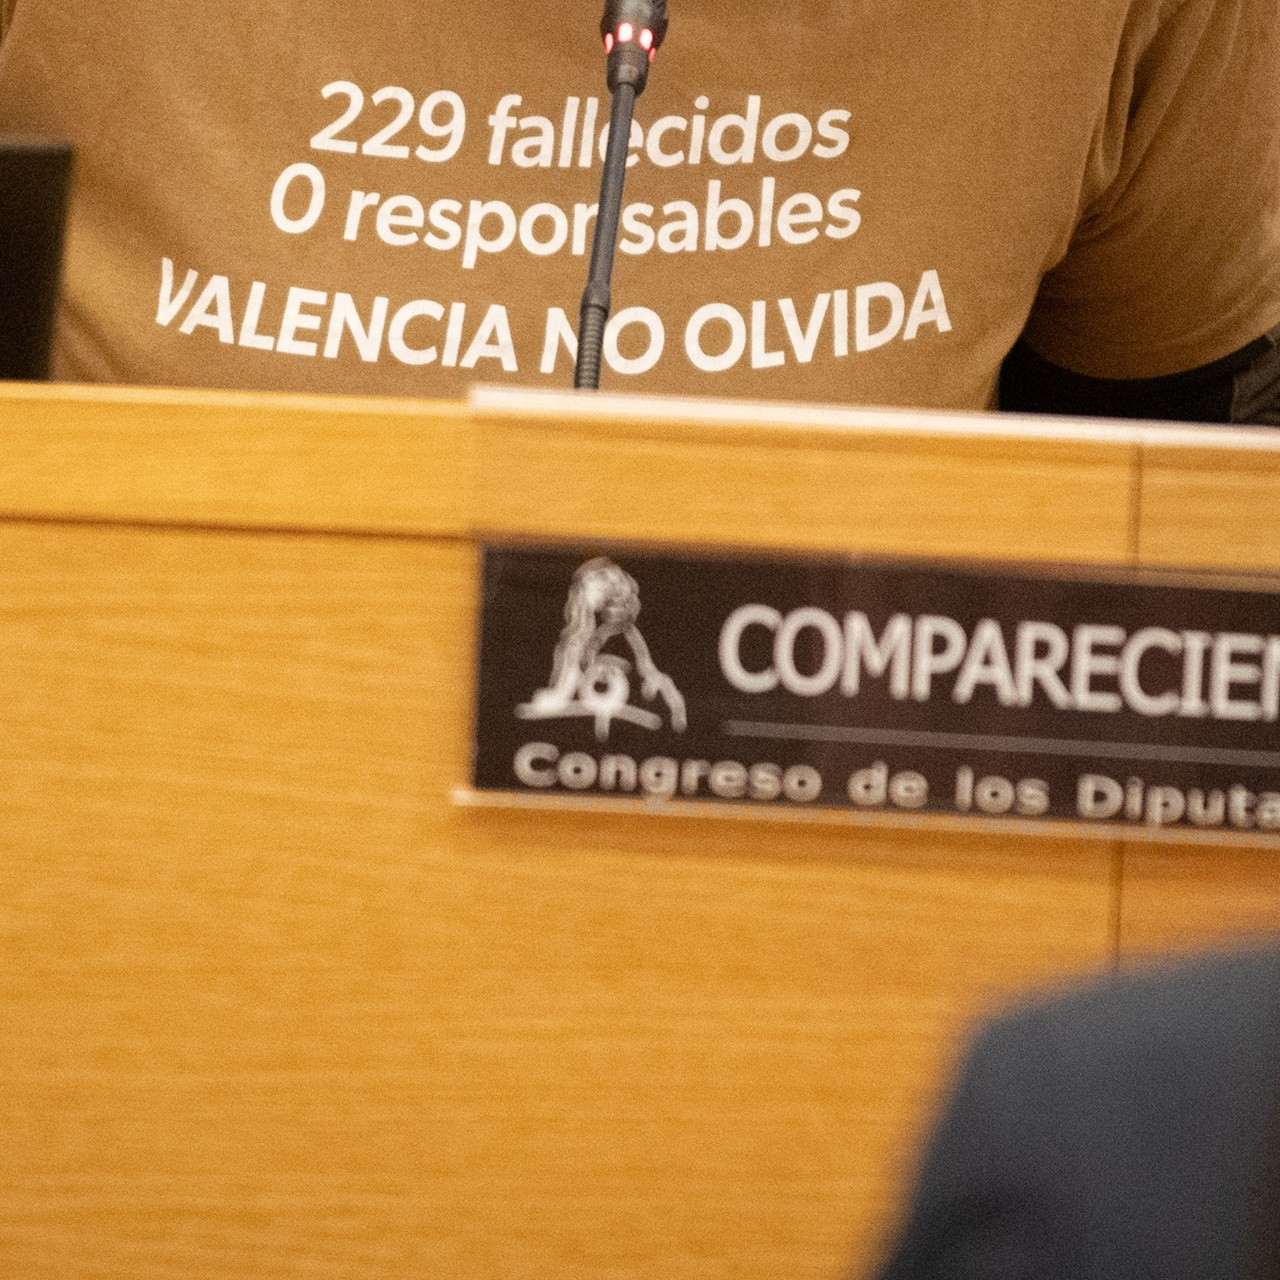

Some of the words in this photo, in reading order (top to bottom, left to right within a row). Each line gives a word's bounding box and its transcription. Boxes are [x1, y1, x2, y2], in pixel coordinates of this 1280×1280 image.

[310, 79, 466, 163] 229
[154, 257, 519, 373] VALENCIA
[684, 269, 952, 369] OLVIDA
[512, 741, 822, 803] Congreso
[847, 762, 929, 808] de
[954, 767, 1051, 817] los
